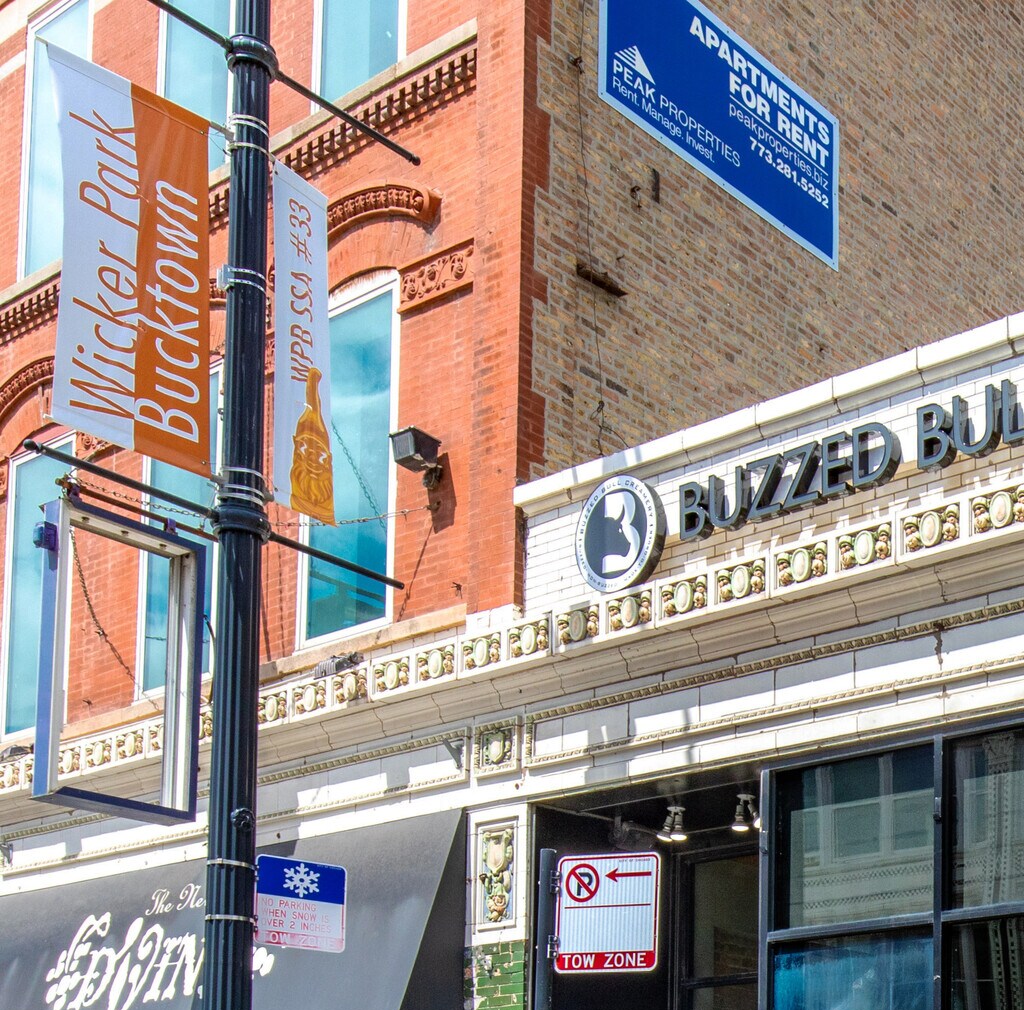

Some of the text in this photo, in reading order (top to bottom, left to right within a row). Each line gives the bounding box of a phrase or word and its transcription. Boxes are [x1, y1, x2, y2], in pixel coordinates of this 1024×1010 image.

[612, 75, 715, 164] Rent. Manage. Invest.
[613, 59, 741, 168] PEAK PROPERTIES
[689, 15, 830, 146] APARTMENTS
[729, 71, 829, 168] FOR RENT
[729, 102, 829, 190] peakproperties.biz
[750, 135, 829, 209] 773.281.5252
[69, 108, 141, 420] Wicker Park
[289, 197, 315, 383] WPB SSA #33
[134, 179, 200, 443] Bucktown
[601, 480, 621, 493] BULL
[679, 422, 900, 541] BUZZED
[145, 883, 206, 915] The Ne
[261, 898, 316, 911] NO PARKING
[261, 909, 329, 923] WHEN SNOW IS
[261, 918, 331, 933] OVER 2 INCHES
[562, 952, 646, 968] TOW ZONE
